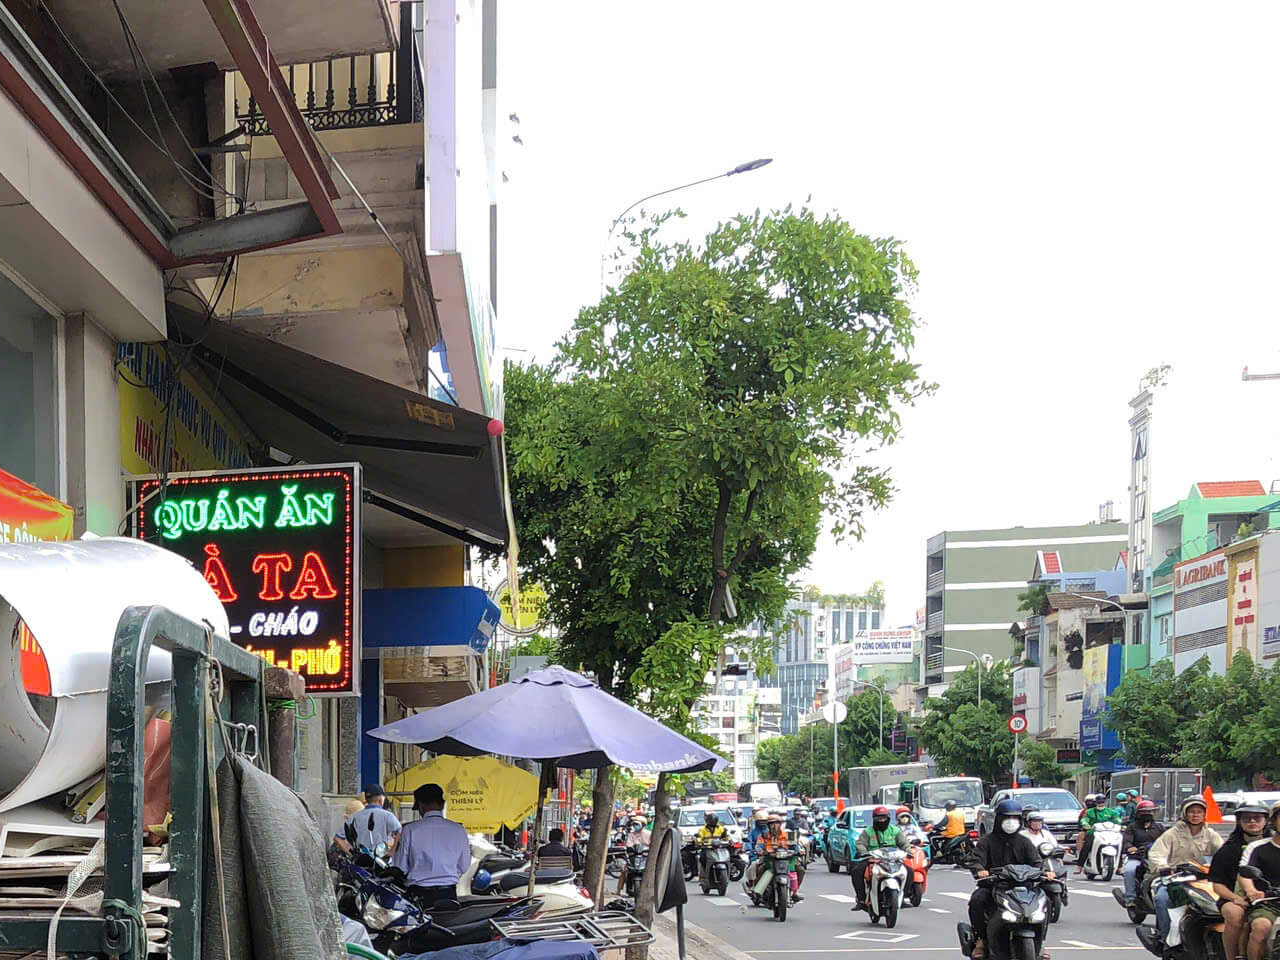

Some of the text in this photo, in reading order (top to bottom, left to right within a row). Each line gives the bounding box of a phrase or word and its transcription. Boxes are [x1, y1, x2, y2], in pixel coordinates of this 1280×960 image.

[153, 484, 335, 539] QUÁN ĂN
[251, 551, 339, 601] TA
[1183, 558, 1227, 587] AGRIBANK
[248, 605, 319, 637] CHÁO
[291, 640, 342, 675] PHỞ
